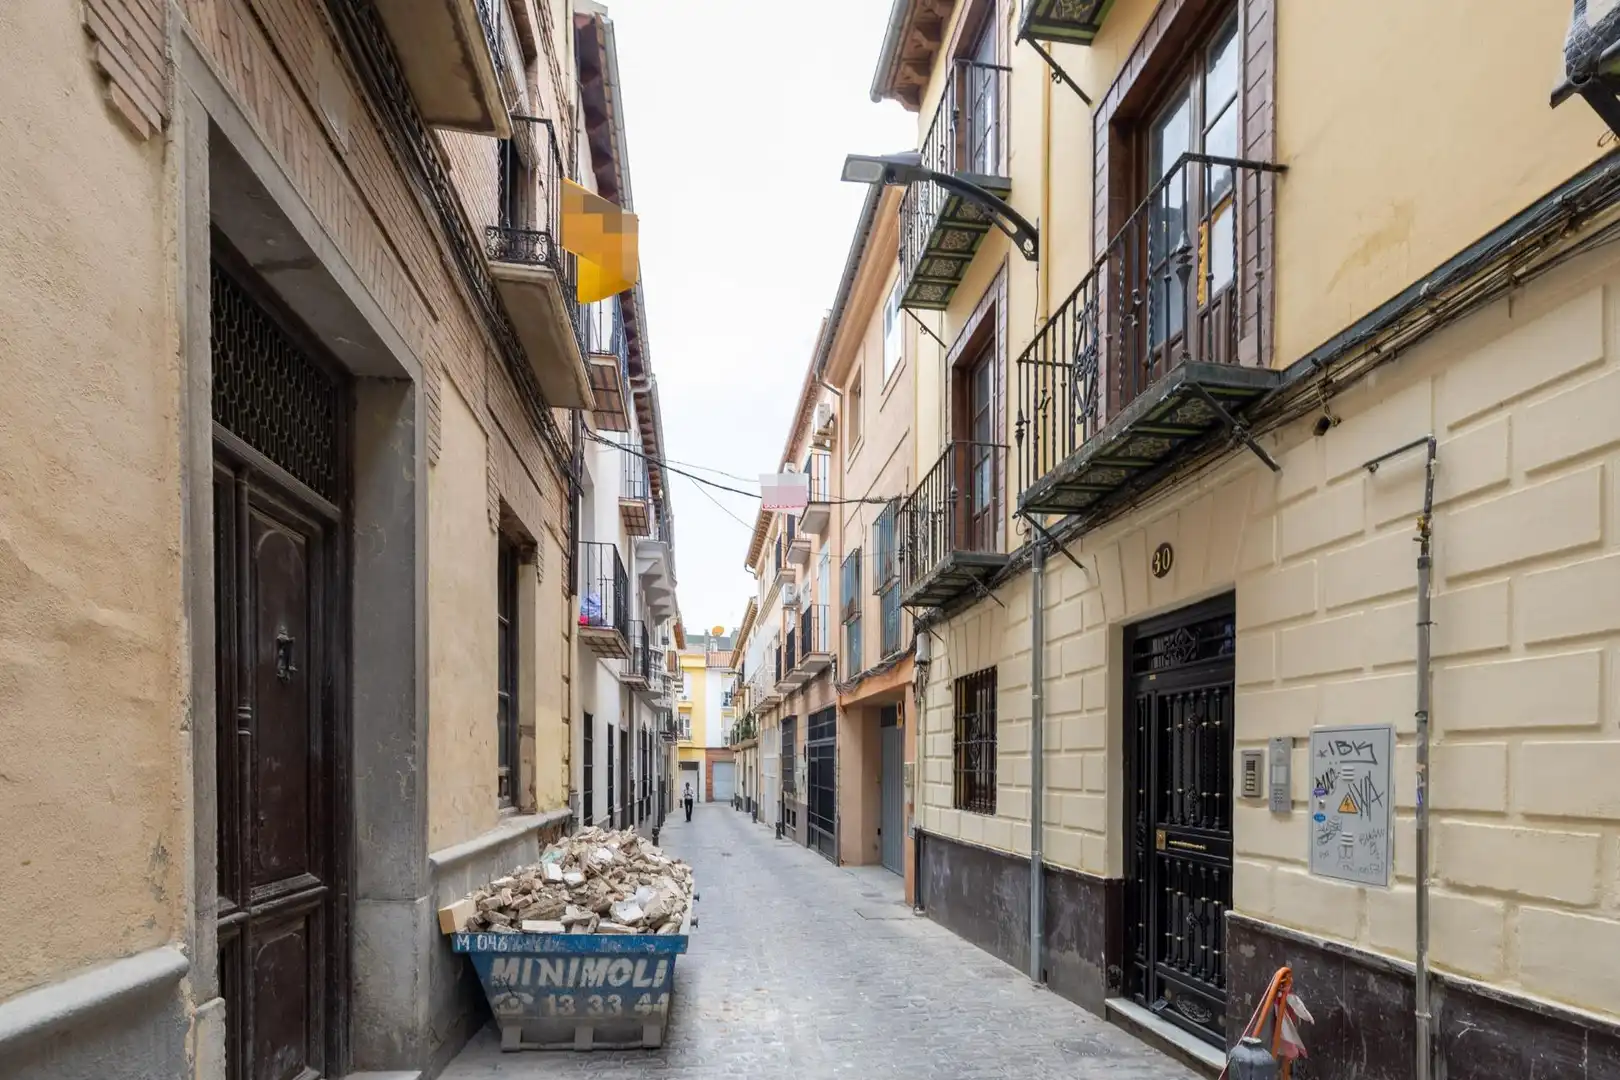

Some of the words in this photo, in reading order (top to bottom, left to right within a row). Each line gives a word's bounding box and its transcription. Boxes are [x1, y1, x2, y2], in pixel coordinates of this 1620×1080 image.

[1152, 547, 1171, 575] 30
[457, 934, 470, 951] M
[492, 958, 668, 988] MINIMOLI
[549, 994, 576, 1016] 13
[587, 994, 622, 1016] 33
